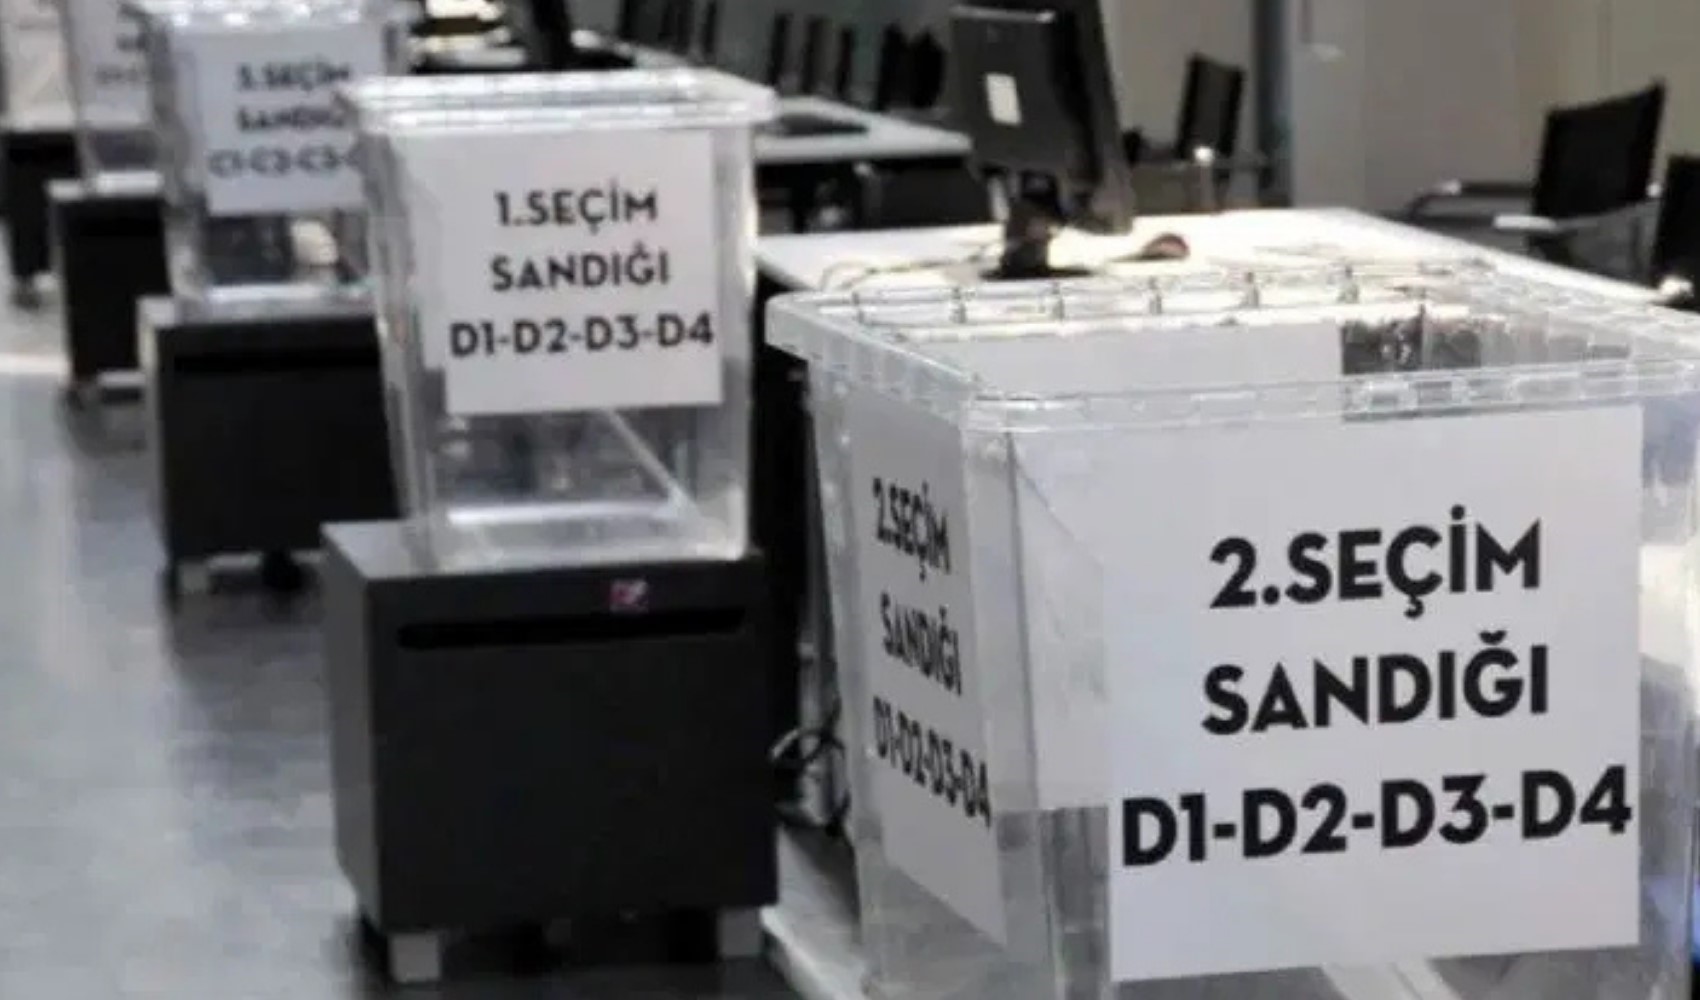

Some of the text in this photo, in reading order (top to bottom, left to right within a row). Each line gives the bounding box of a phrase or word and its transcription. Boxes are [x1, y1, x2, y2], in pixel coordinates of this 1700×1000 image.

[495, 180, 658, 234] 1.SEÇİM
[490, 242, 670, 292] SANDIĞI
[450, 310, 714, 358] D1-D2-D3-D4
[1210, 505, 1540, 619] 2.SEÇİM
[881, 592, 962, 696] SANDIĞI
[1201, 630, 1548, 736] SANDIĞI
[873, 696, 991, 828] D1-D2-D3-D4
[1122, 765, 1632, 867] D1-D2-D3-D4
